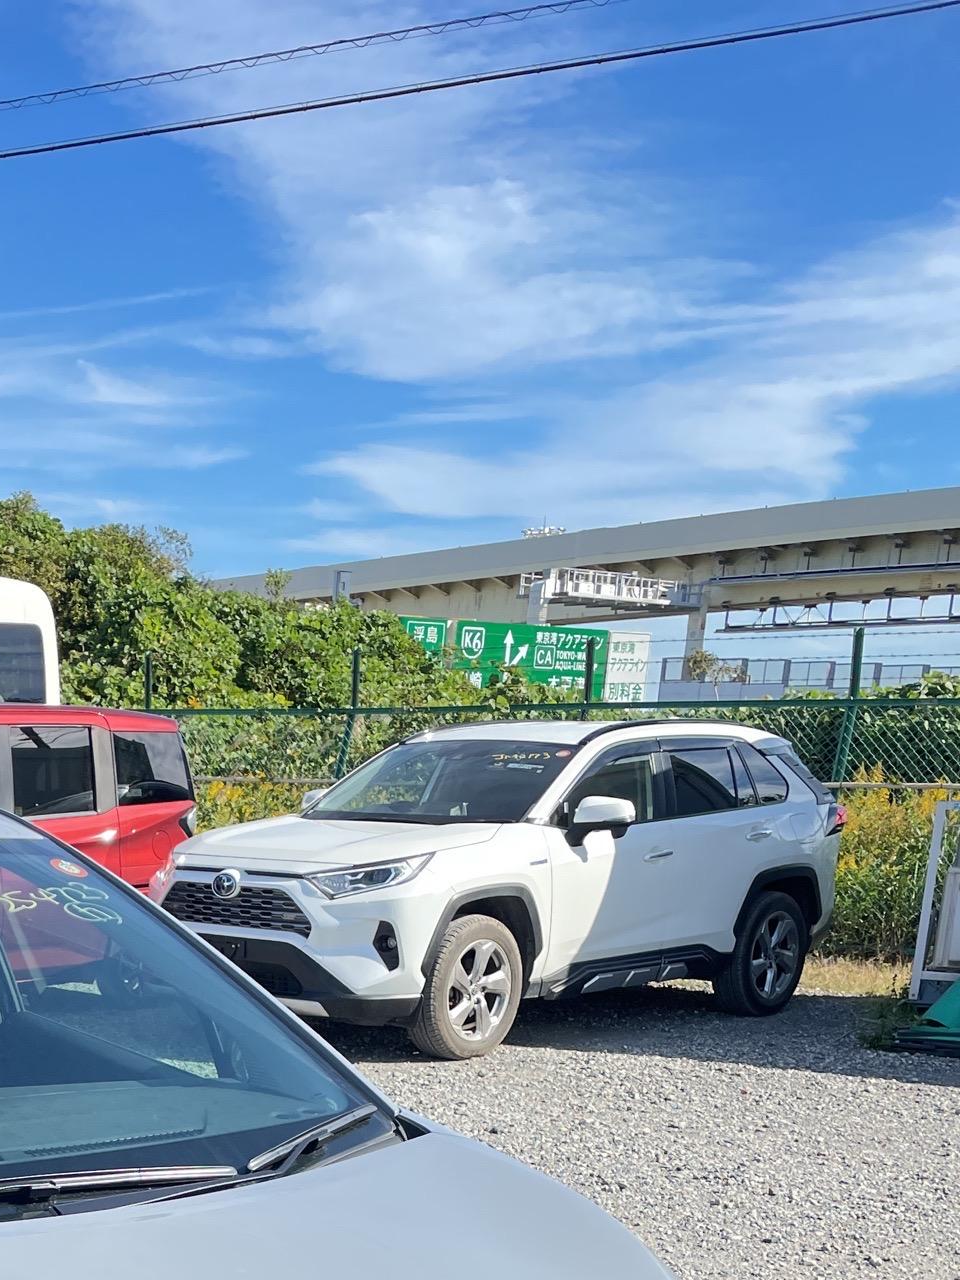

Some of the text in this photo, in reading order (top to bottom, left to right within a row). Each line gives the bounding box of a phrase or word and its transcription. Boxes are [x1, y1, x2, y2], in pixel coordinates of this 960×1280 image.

[464, 631, 481, 652] K6
[535, 631, 604, 650] 東京湾アクアラン
[536, 649, 552, 665] CA
[556, 650, 587, 661] TOKYO-WA
[608, 683, 643, 701] 別料金
